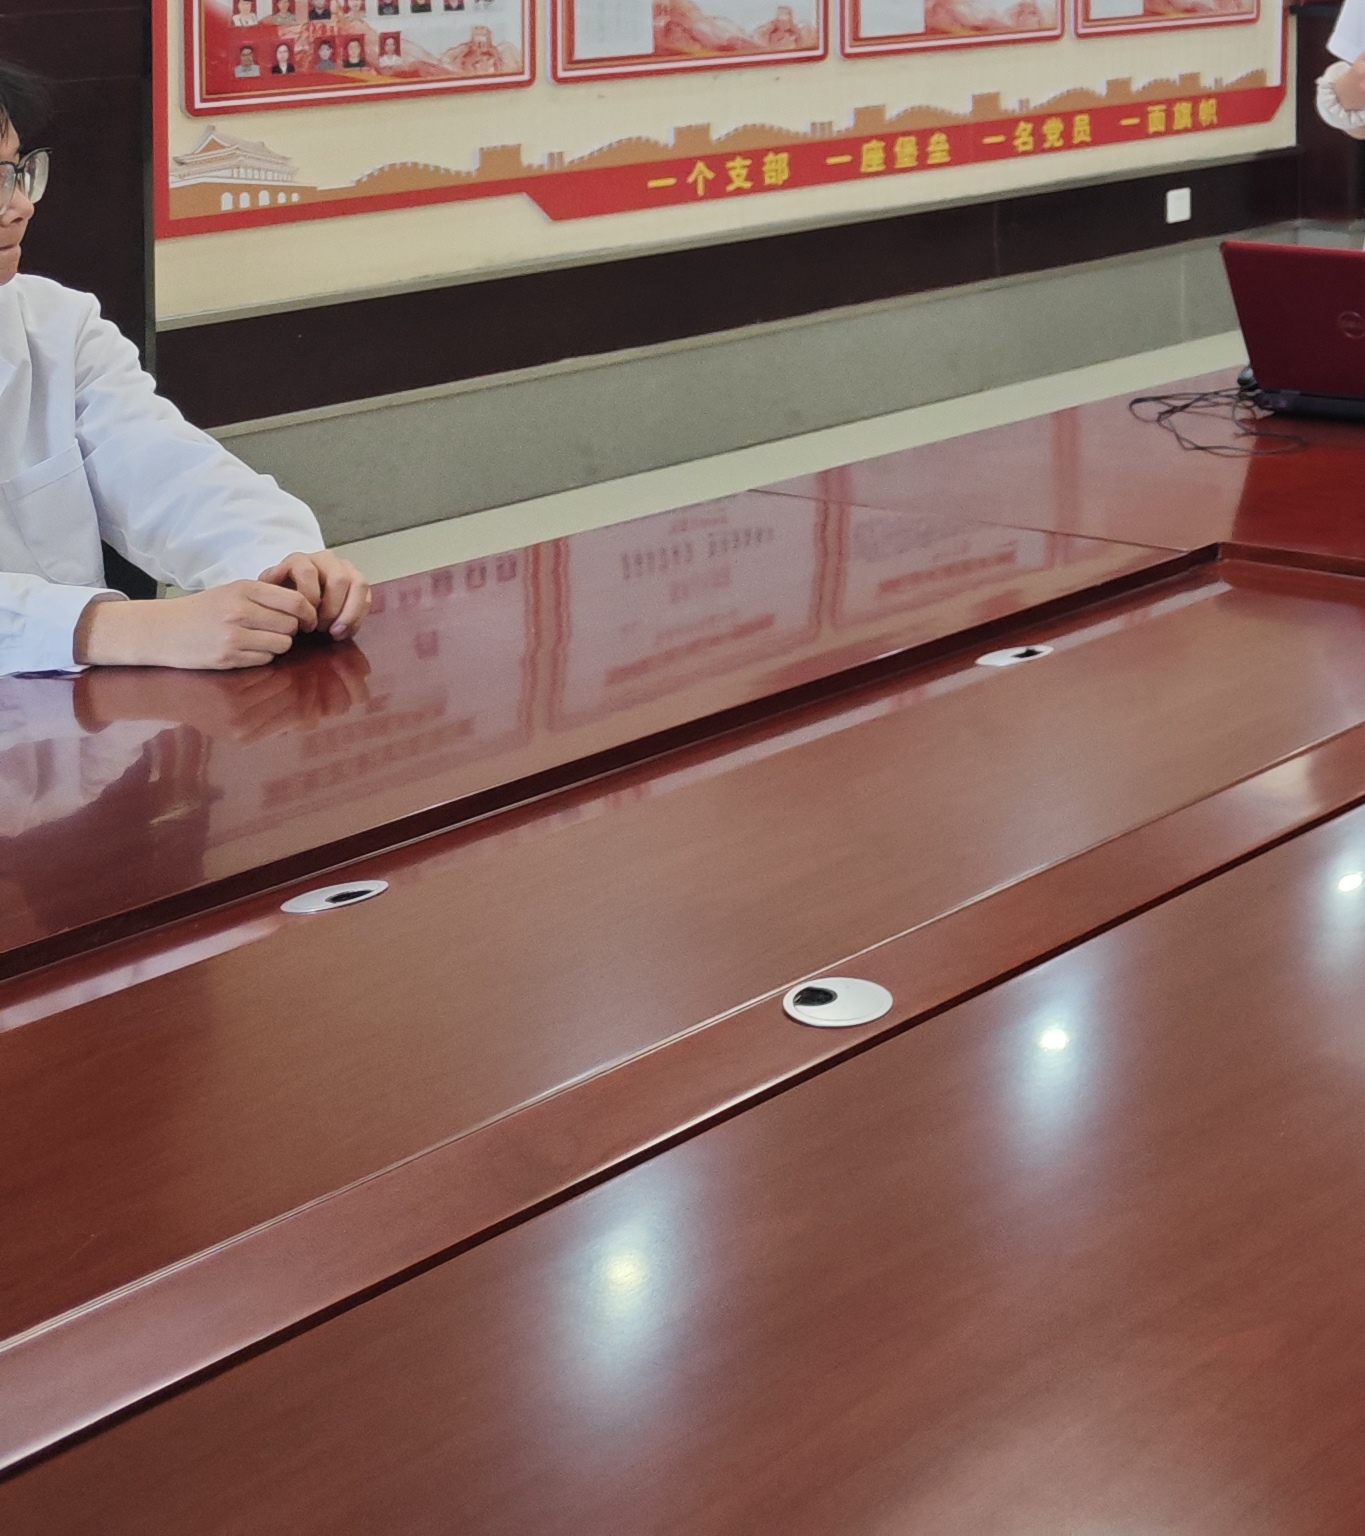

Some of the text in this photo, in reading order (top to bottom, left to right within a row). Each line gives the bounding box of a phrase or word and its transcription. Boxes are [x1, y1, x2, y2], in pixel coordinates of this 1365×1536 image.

[647, 97, 1218, 197] 一个支部 一座堡垒 一名党员 一面旗帜
